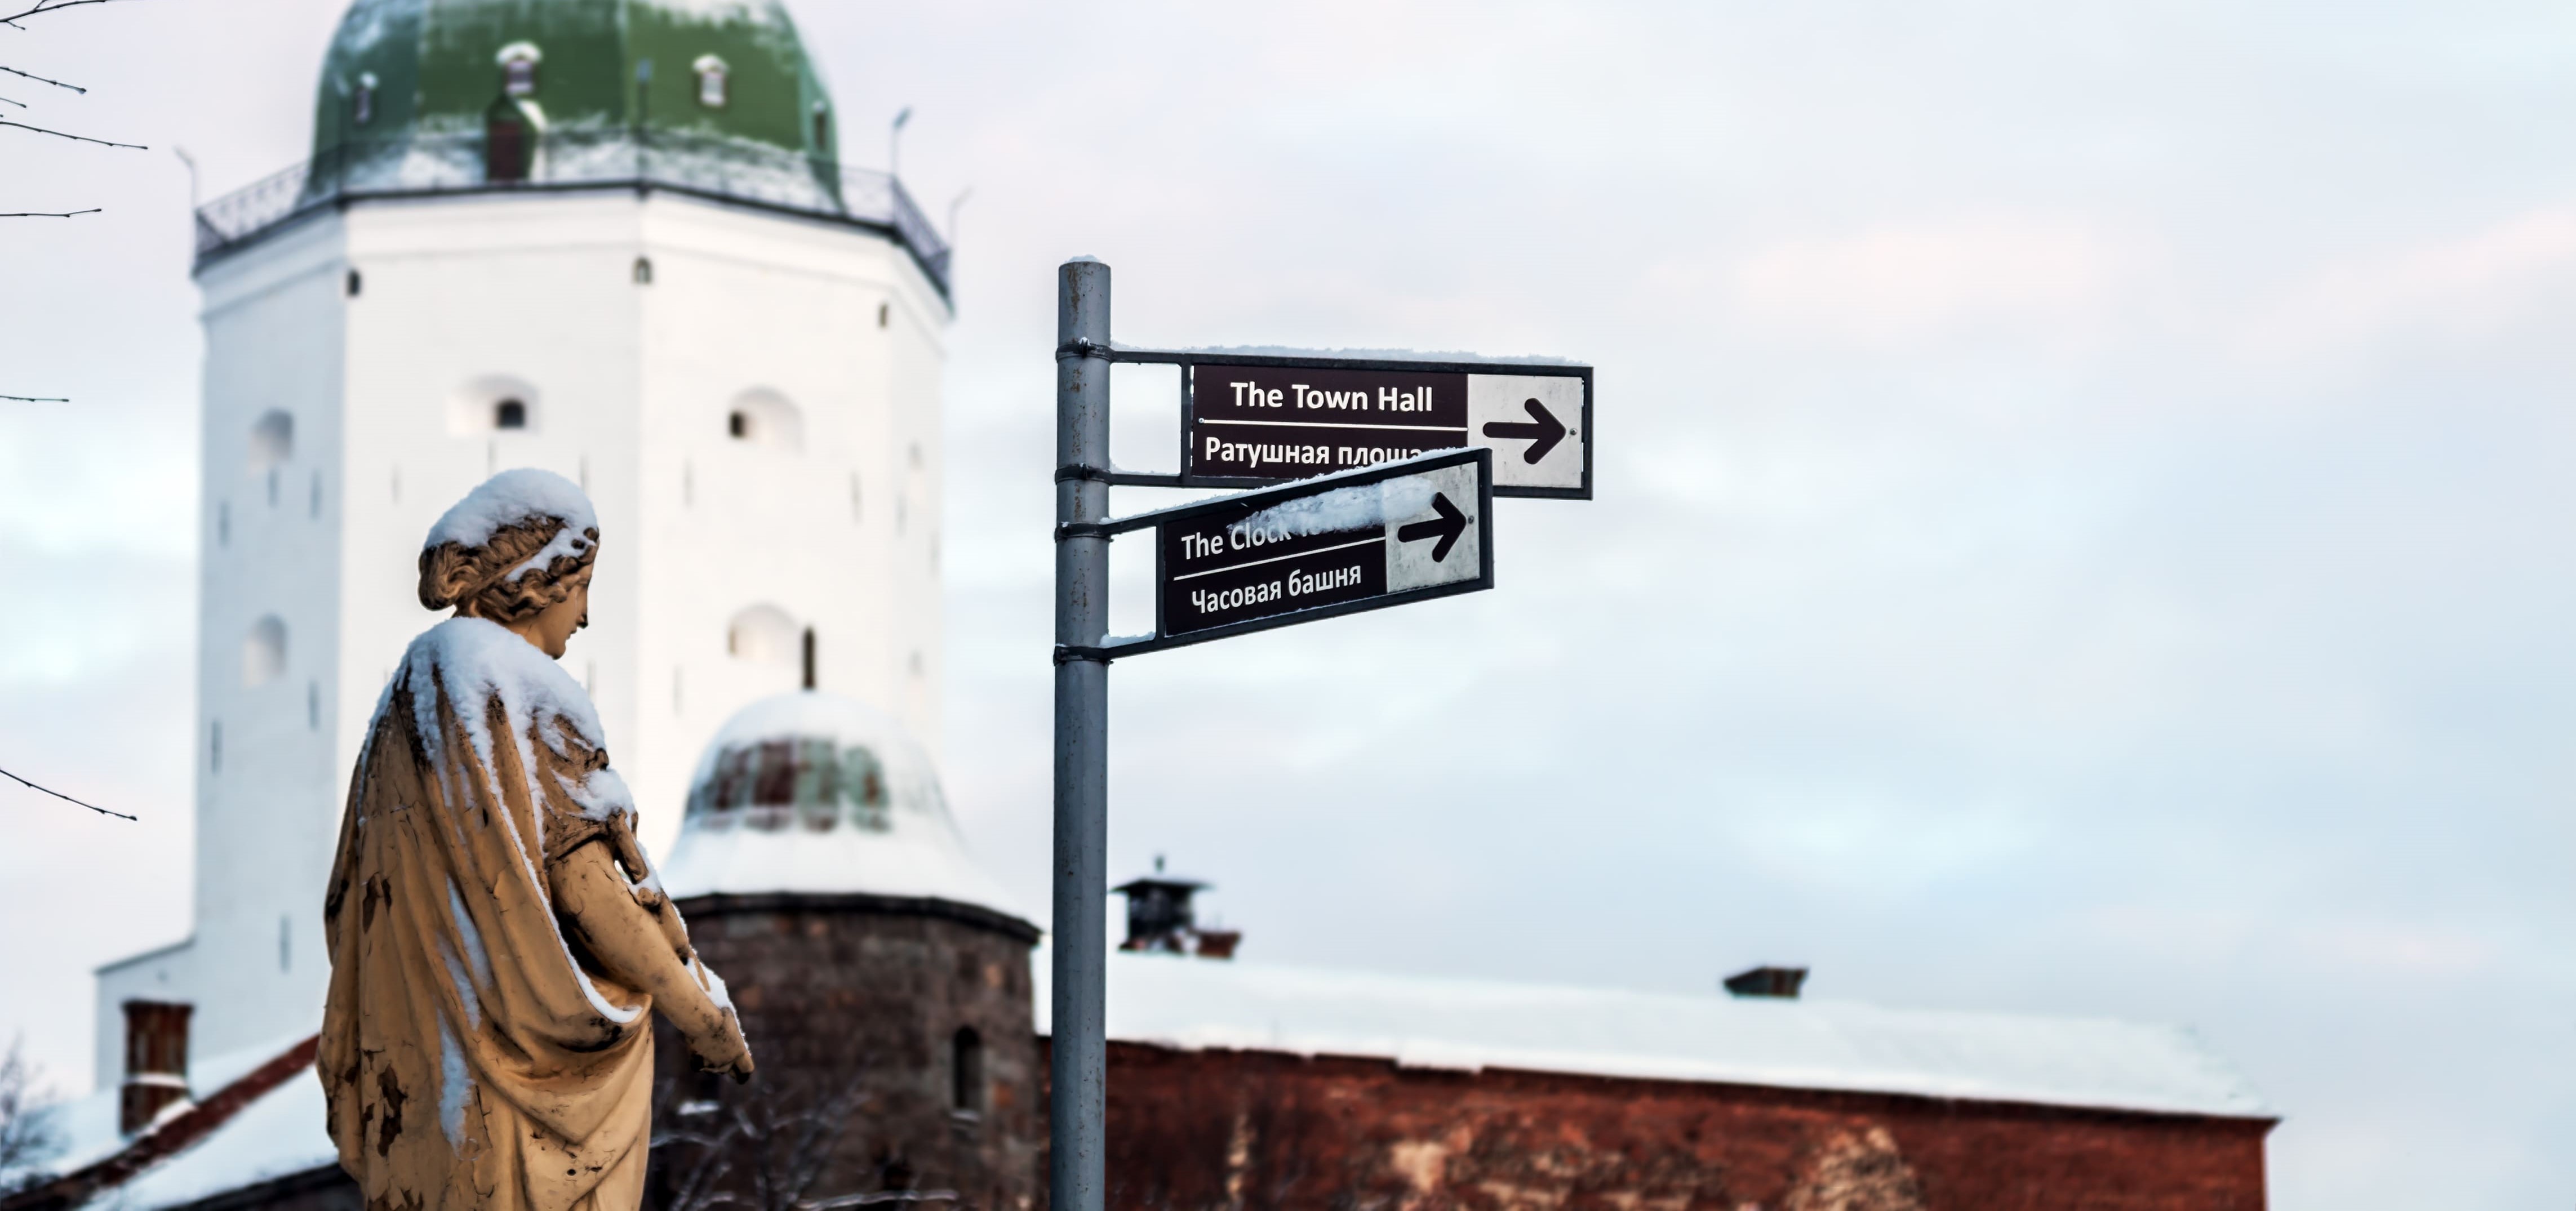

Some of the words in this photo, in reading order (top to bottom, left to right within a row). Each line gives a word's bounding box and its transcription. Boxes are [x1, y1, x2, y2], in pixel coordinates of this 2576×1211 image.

[1230, 382, 1283, 408] The
[1291, 384, 1368, 410] Town
[1378, 386, 1432, 412] Hall
[1206, 437, 1330, 468] Ратушная
[1181, 531, 1223, 560] The
[1192, 580, 1281, 613] Часовая
[1289, 565, 1361, 596] башня
